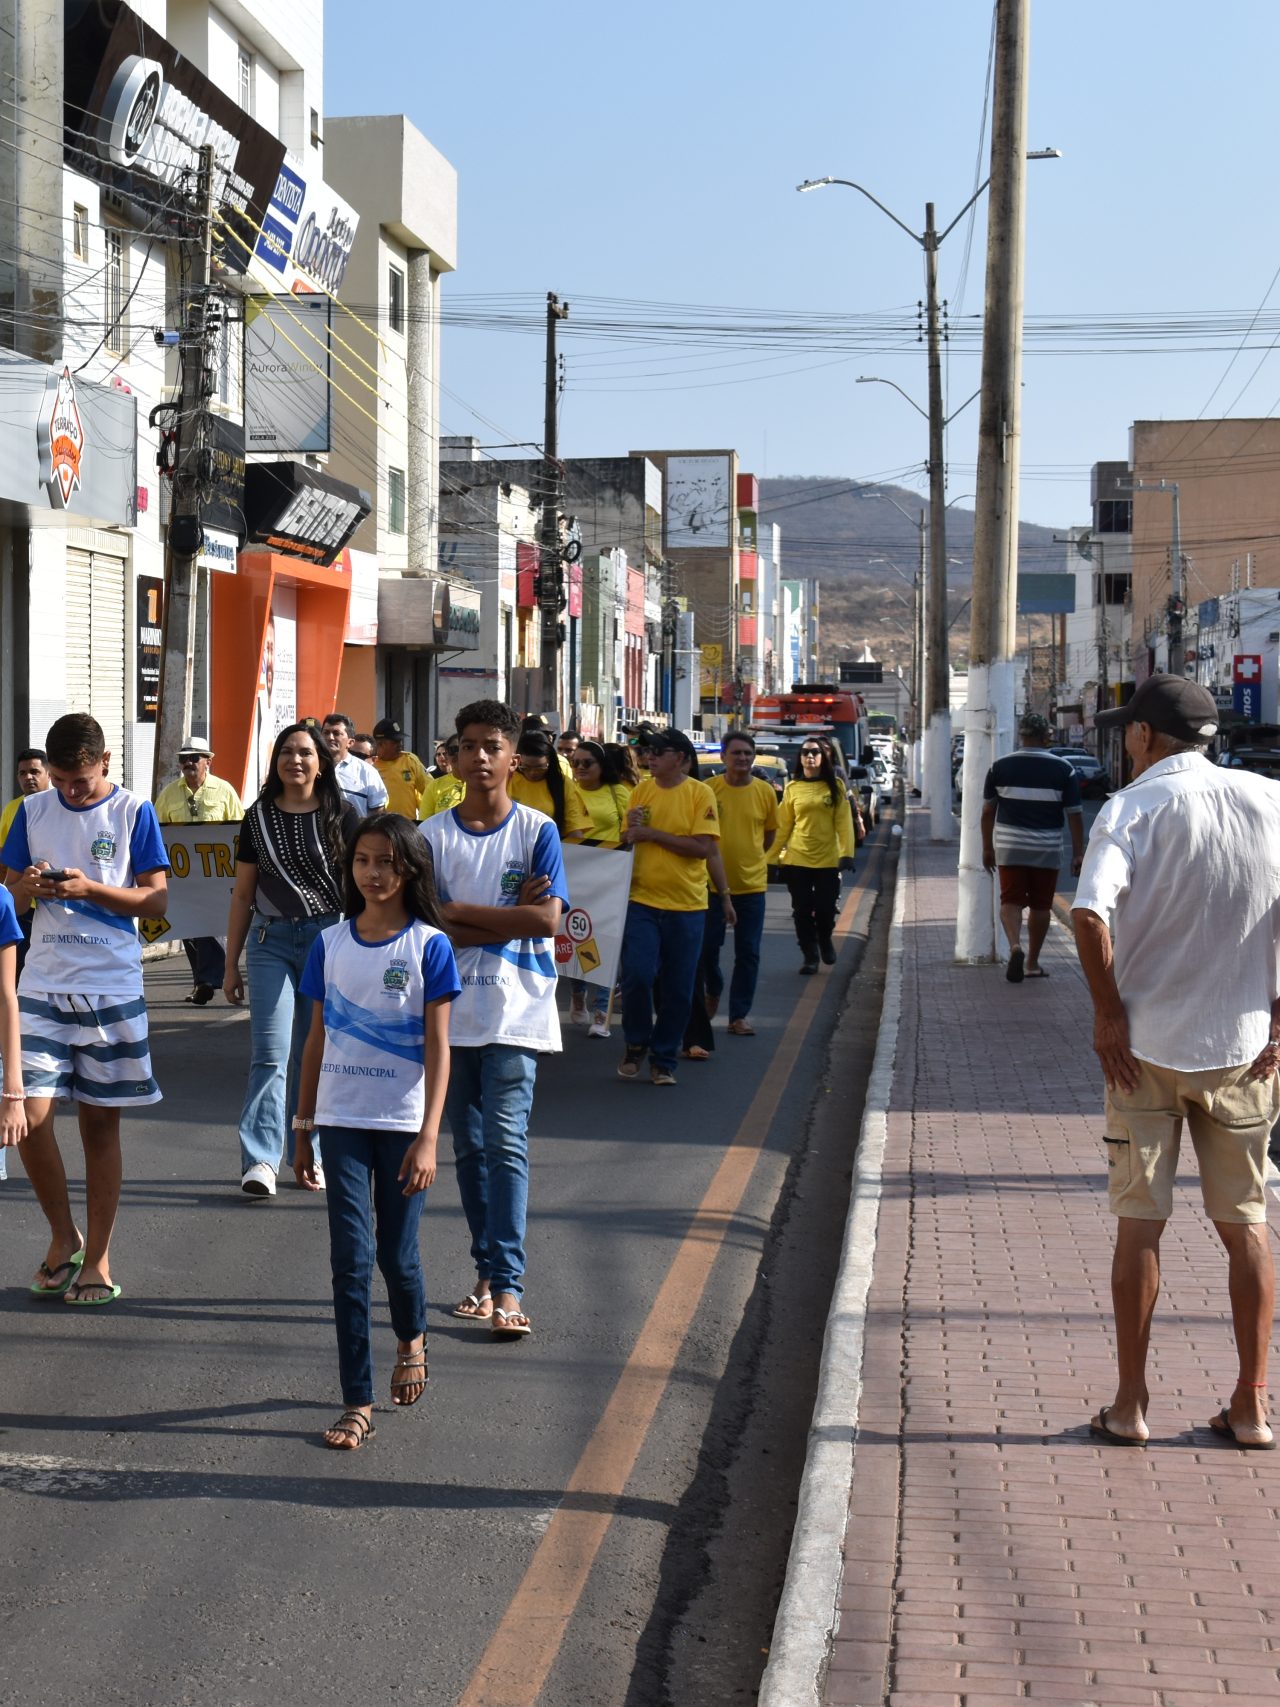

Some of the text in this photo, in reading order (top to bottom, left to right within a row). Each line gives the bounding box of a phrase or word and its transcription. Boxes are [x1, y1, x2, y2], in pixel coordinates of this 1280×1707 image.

[274, 173, 303, 215] DENTISTA
[572, 916, 586, 931] 50
[58, 934, 111, 945] MUNICIPAL
[555, 943, 572, 954] ARE
[342, 1065, 397, 1078] MUNICIPAL
